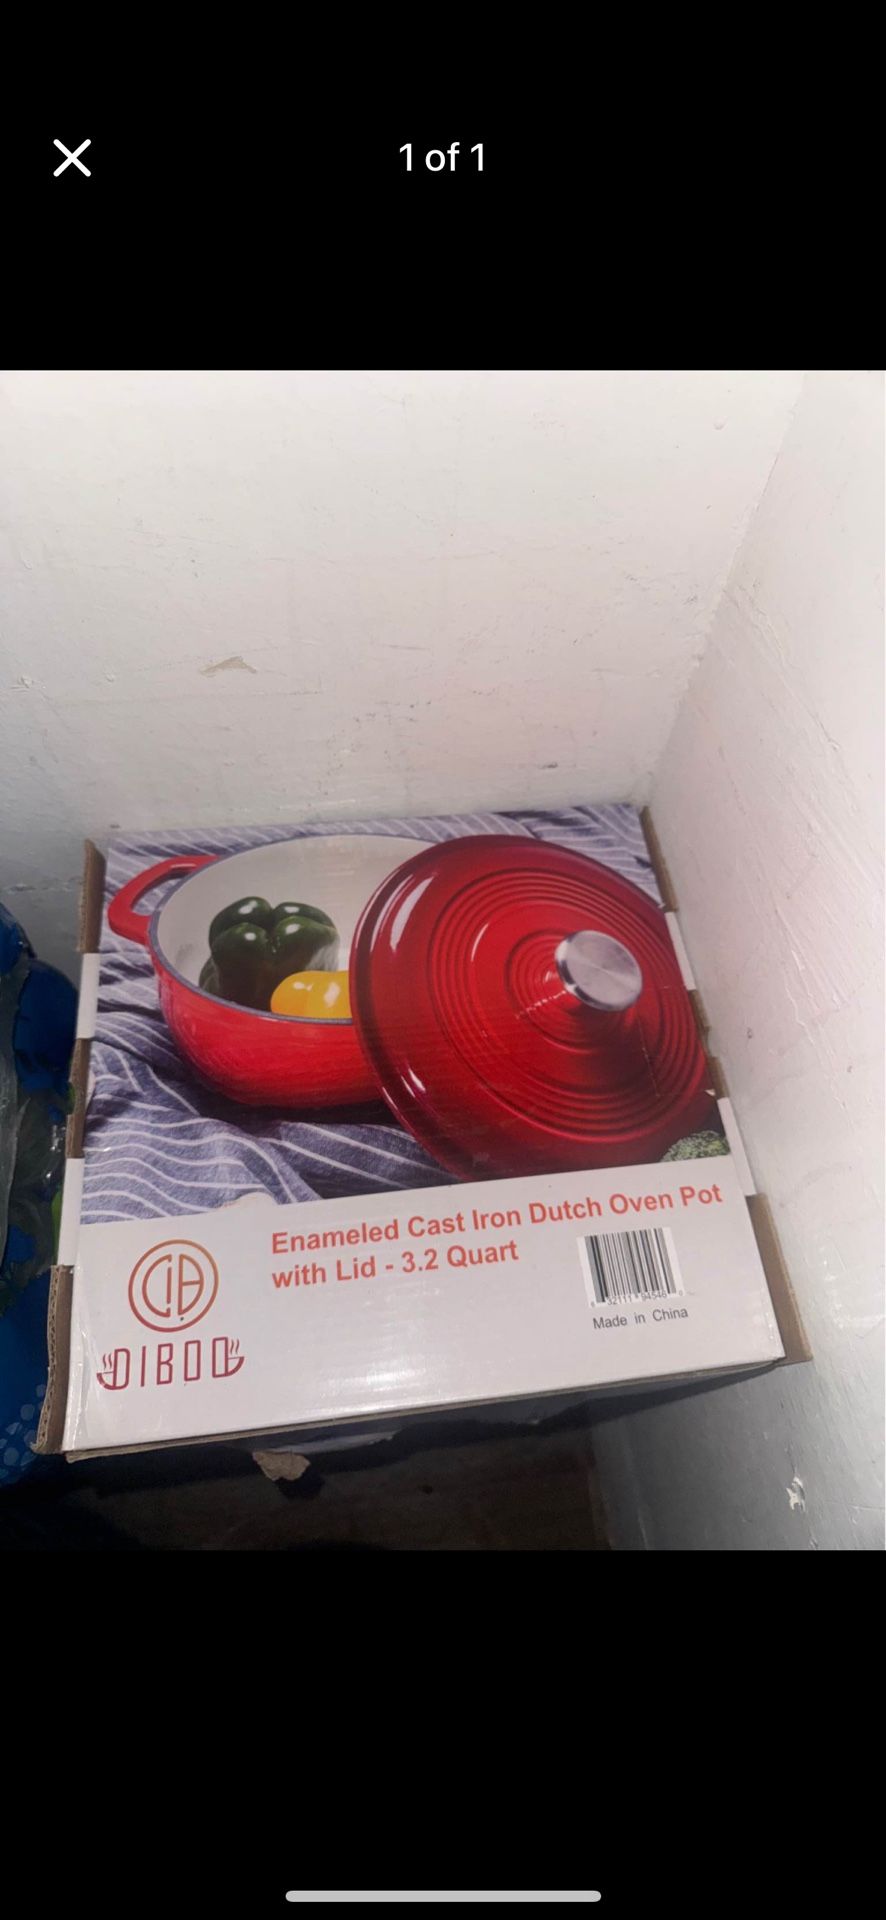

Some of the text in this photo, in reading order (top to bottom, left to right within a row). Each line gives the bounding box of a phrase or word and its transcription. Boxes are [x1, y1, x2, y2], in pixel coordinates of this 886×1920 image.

[271, 1184, 723, 1254] Enameled Cast Iron Dutch Oven Pot
[271, 1263, 327, 1288] with
[335, 1257, 377, 1281] Lid
[402, 1247, 439, 1273] 3.2
[447, 1239, 519, 1268] Quart
[592, 1307, 689, 1330] Made in China
